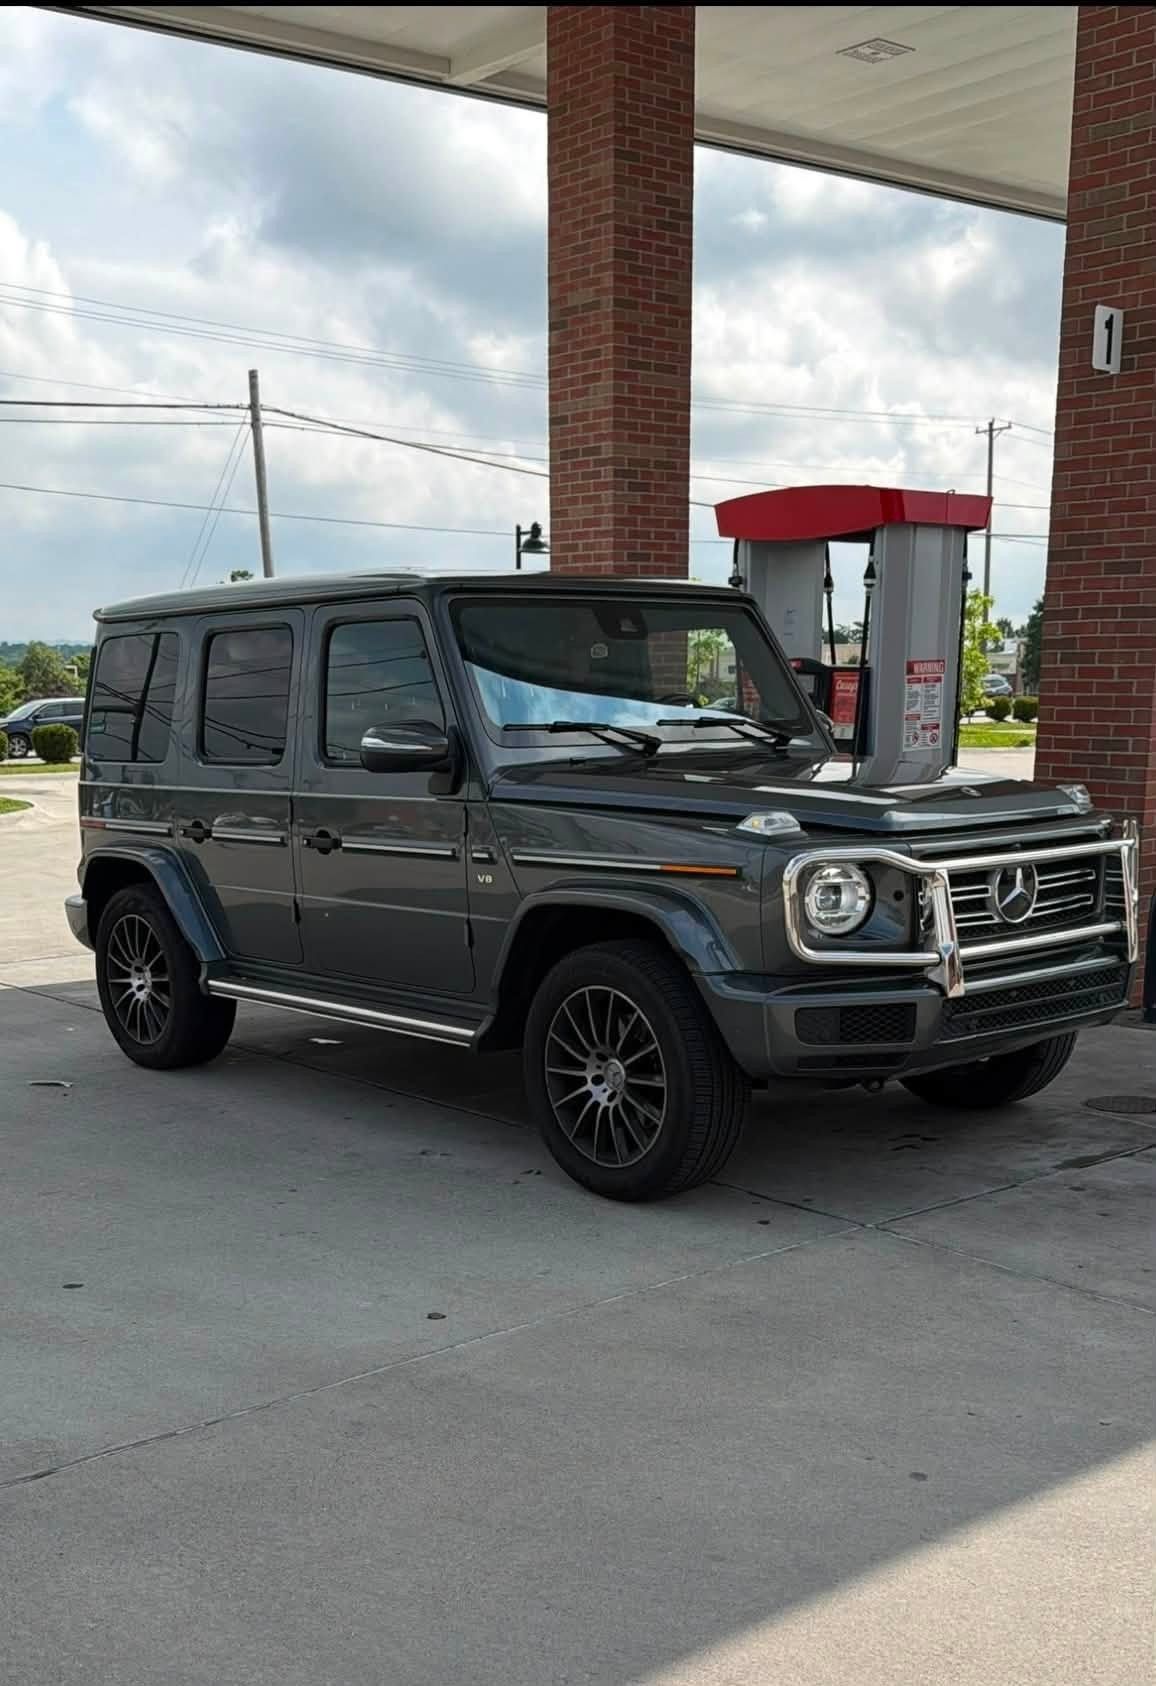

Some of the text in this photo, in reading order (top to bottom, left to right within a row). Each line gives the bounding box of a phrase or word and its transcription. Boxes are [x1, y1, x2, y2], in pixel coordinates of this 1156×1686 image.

[1105, 313, 1114, 365] 1
[913, 662, 944, 674] WARNING
[477, 874, 493, 884] V8
